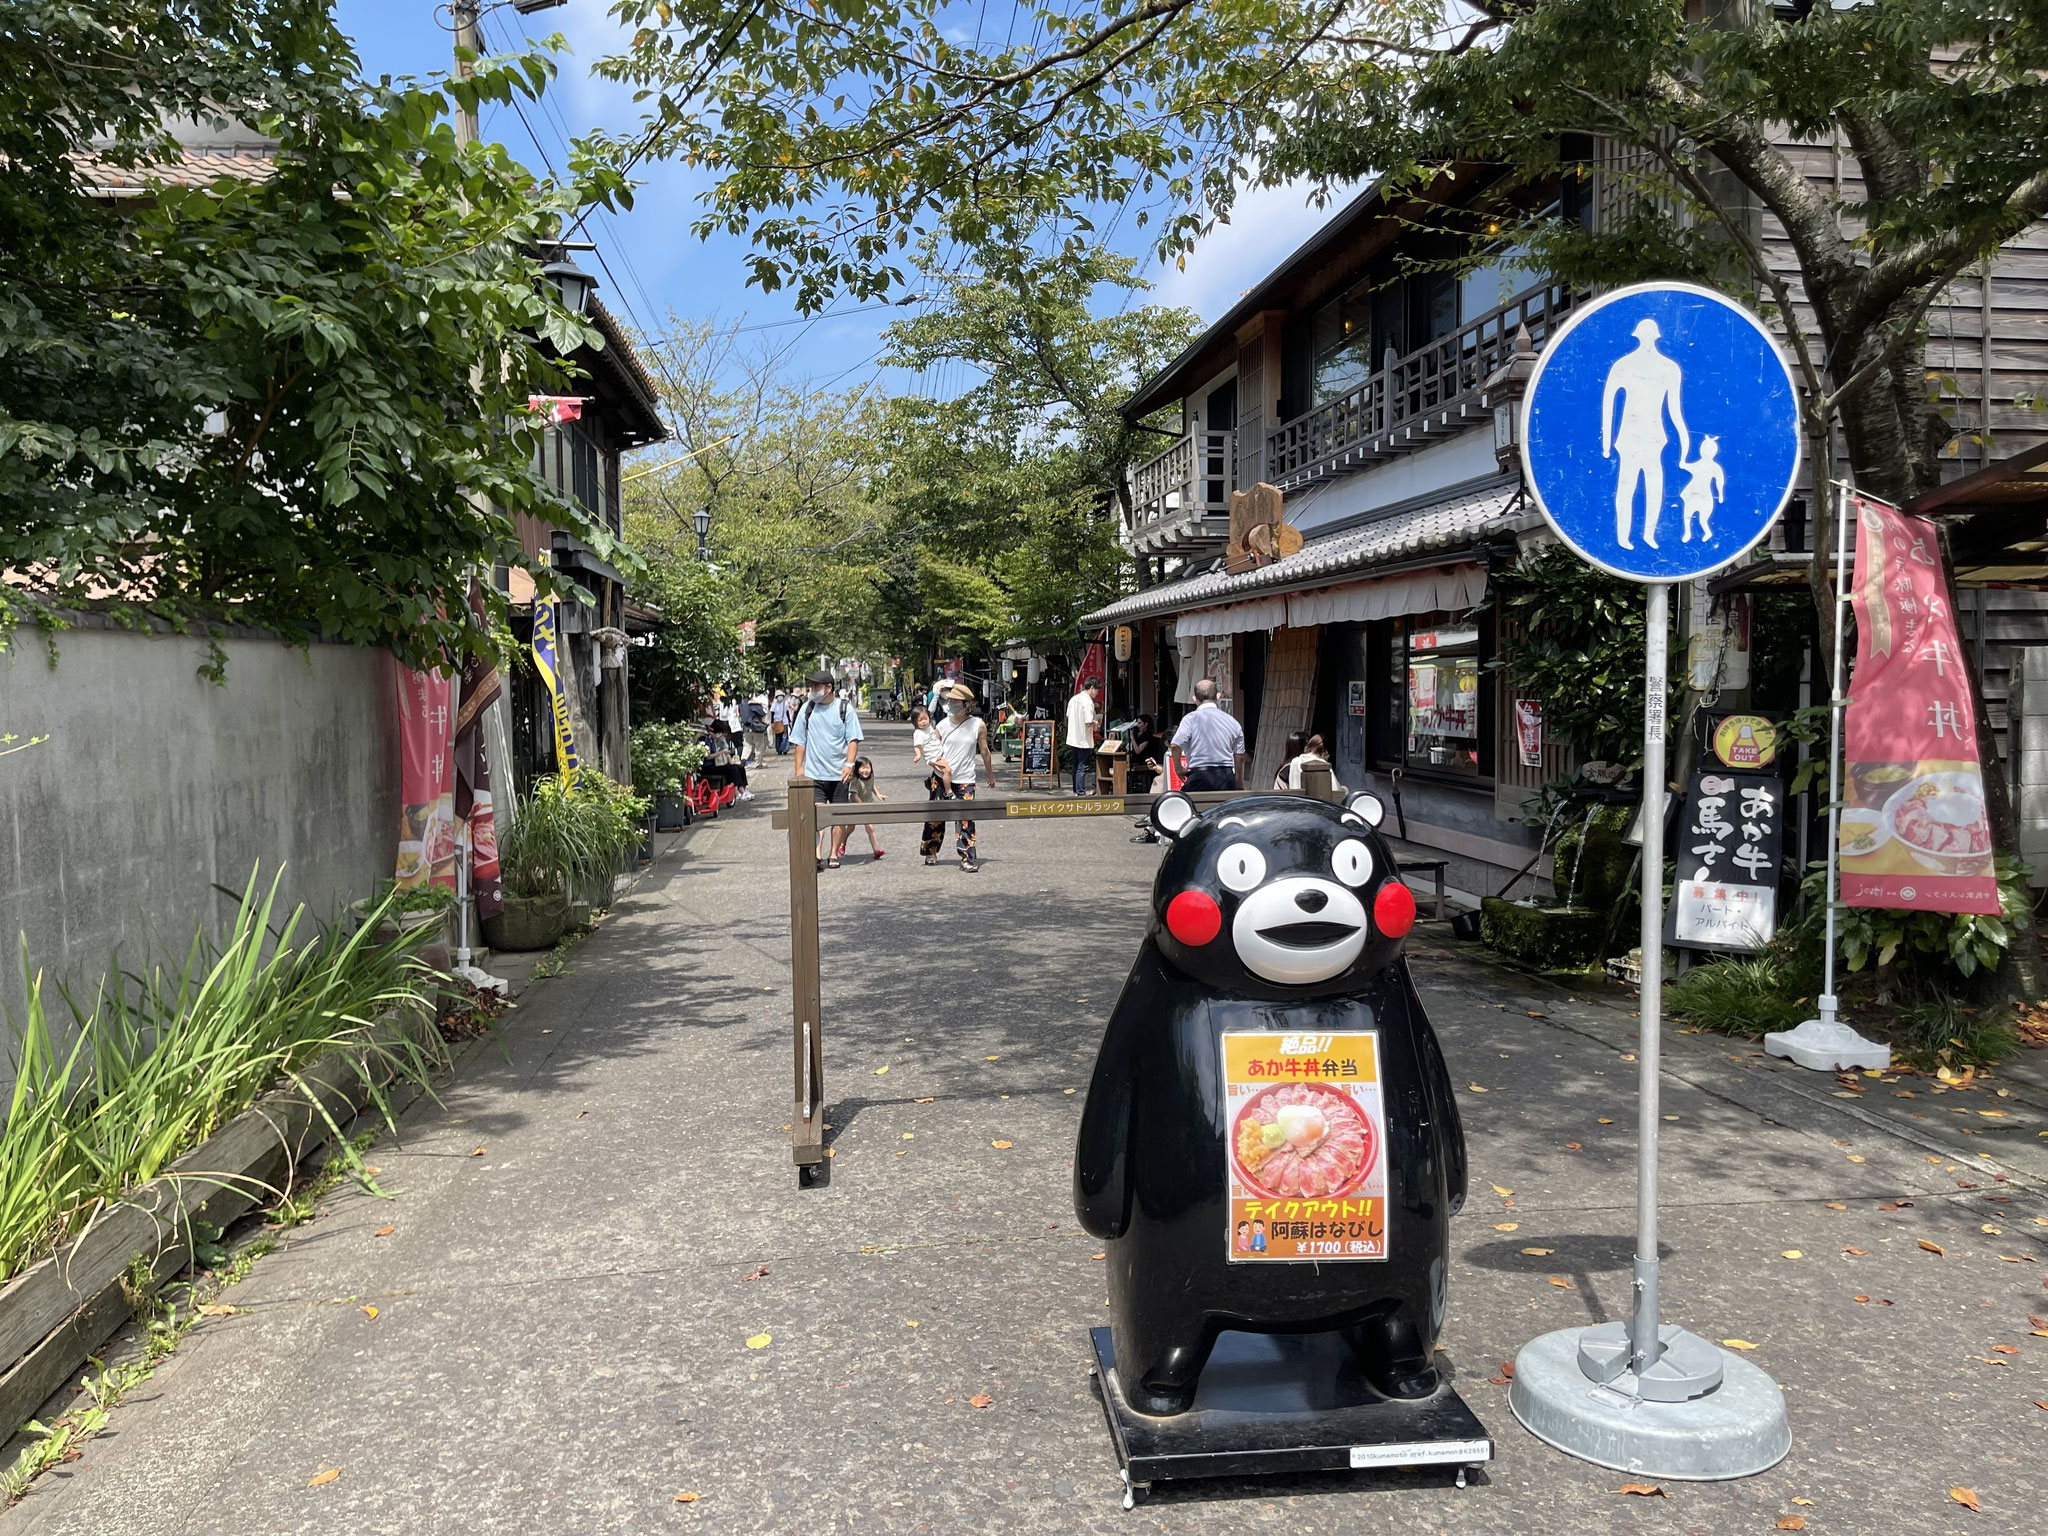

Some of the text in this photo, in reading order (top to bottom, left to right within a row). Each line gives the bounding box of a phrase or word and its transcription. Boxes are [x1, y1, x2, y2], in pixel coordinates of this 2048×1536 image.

[1648, 676, 1663, 740] 警察署長
[1010, 802, 1120, 814] ロードバイクサドルラック
[1732, 786, 1774, 880] あか牛
[1695, 918, 1748, 931] アルバイト
[1279, 1036, 1333, 1055] 絶品!!
[1247, 1058, 1358, 1077] あか牛丼弁当
[1245, 1200, 1372, 1220] テイクアウト!!
[1271, 1220, 1384, 1240] 阿蘇はなびし
